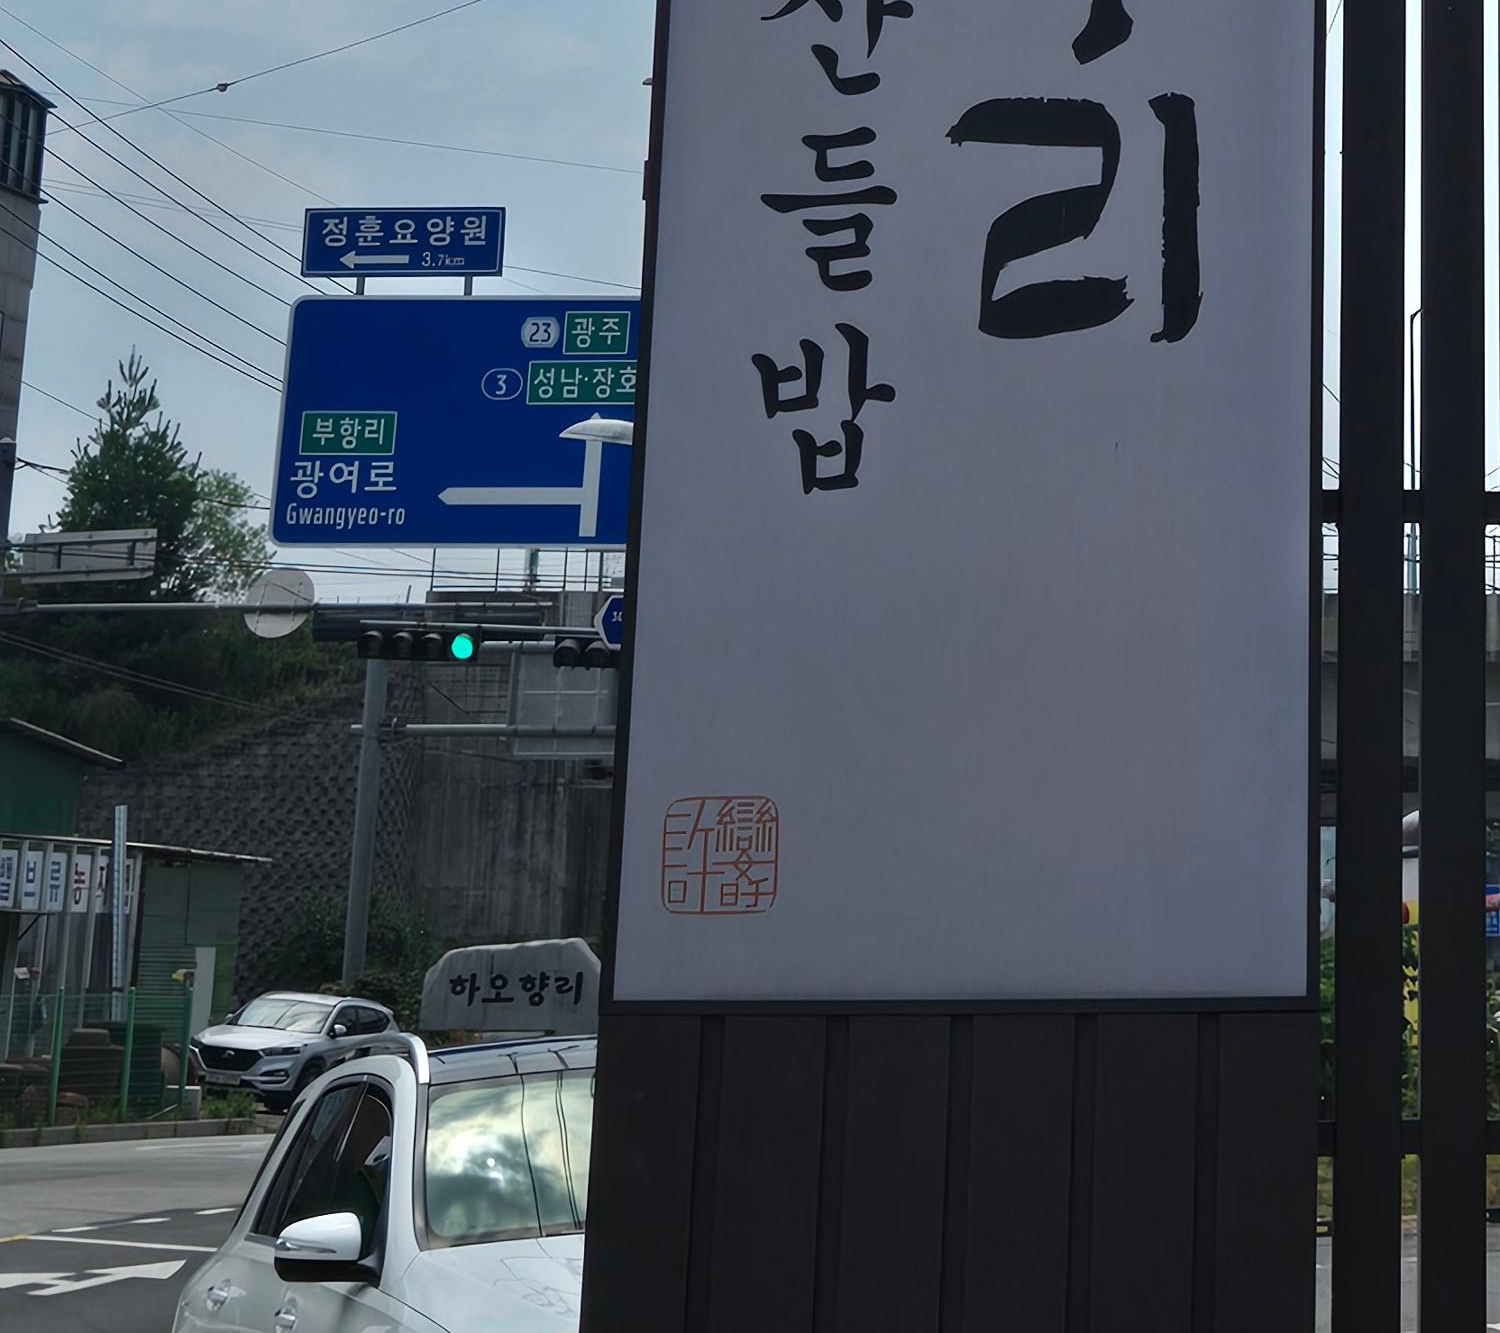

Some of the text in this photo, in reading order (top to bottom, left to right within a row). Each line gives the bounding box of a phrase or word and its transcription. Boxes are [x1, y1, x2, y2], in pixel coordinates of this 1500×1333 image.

[321, 215, 487, 247] 정훈요양원
[421, 251, 465, 268] 3.7km
[529, 317, 622, 348] 23 광주
[495, 374, 507, 395] 3
[312, 417, 385, 449] 부항리
[290, 460, 397, 498] 광여로
[286, 502, 406, 530] Gwangyeo-ro
[449, 971, 584, 1007] 하오향리
